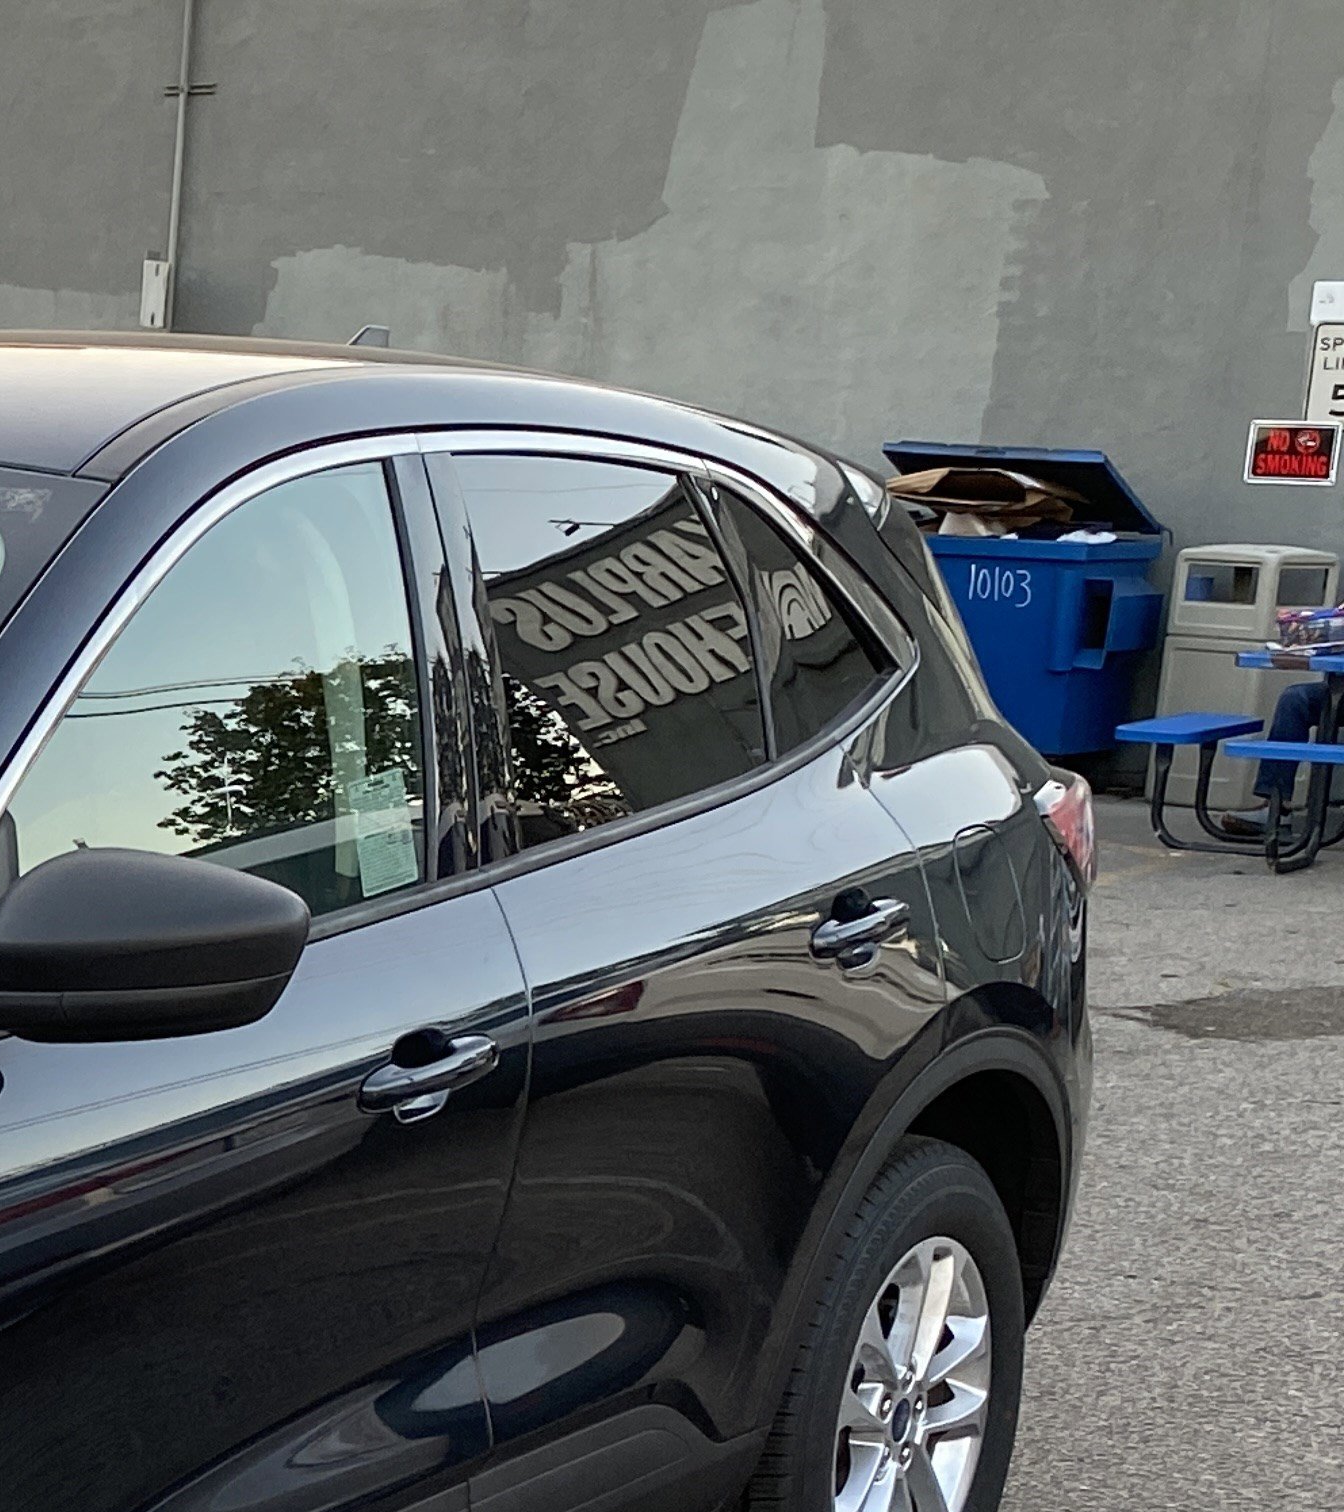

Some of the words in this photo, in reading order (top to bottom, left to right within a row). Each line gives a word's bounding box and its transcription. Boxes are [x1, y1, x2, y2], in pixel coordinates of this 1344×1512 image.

[1267, 429, 1290, 452] NO
[1255, 453, 1328, 476] SMOKING
[968, 563, 1031, 608] 10103
